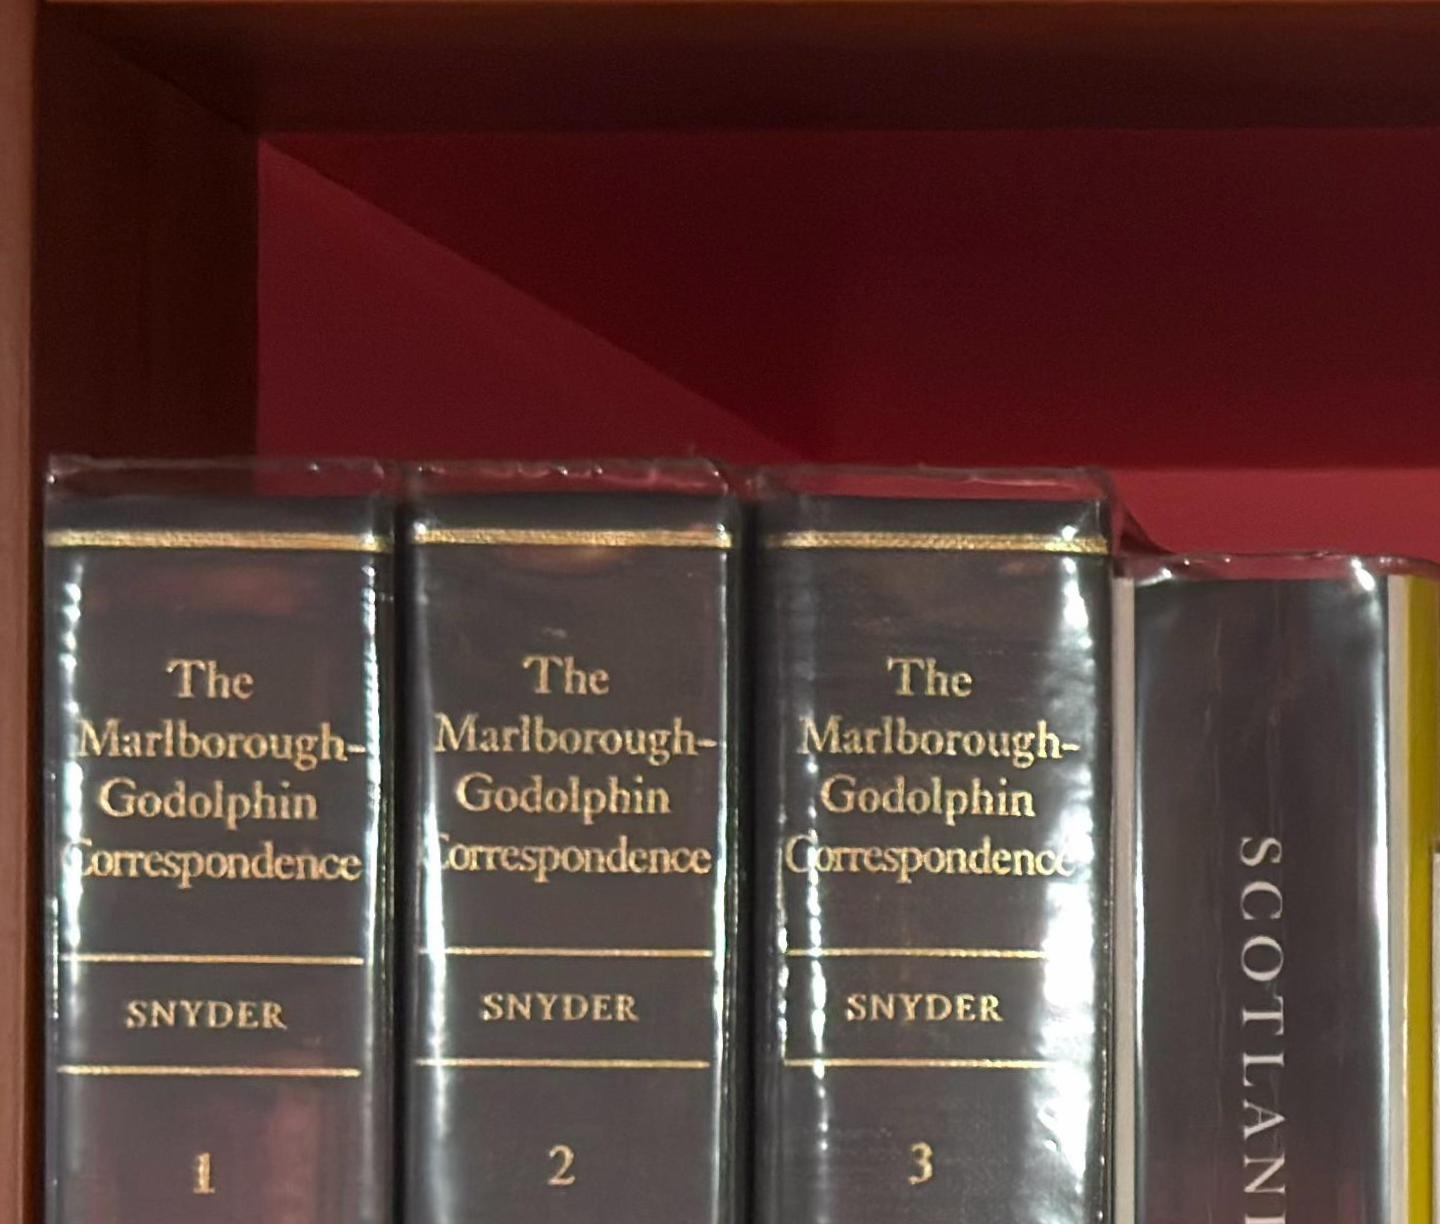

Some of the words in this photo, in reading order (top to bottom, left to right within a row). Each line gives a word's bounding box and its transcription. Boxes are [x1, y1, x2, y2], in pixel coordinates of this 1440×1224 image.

[166, 658, 254, 699] The
[522, 654, 611, 696] The
[887, 656, 974, 698] The
[77, 717, 365, 771] Marlborough-
[434, 711, 719, 766] Marlborough-
[797, 715, 1081, 769] Marlborough-
[98, 777, 319, 830] Godolphin
[456, 772, 672, 825] Godolphin
[820, 774, 1036, 827] Godolphin
[62, 838, 362, 889] Correspondence
[785, 834, 1078, 884] Correspondence
[126, 999, 287, 1031] SNYDER
[482, 992, 640, 1023] SNYDER
[845, 992, 1003, 1023] SNYDER
[193, 1152, 216, 1195] 1
[547, 1145, 576, 1186] 2
[907, 1143, 935, 1186] 3
